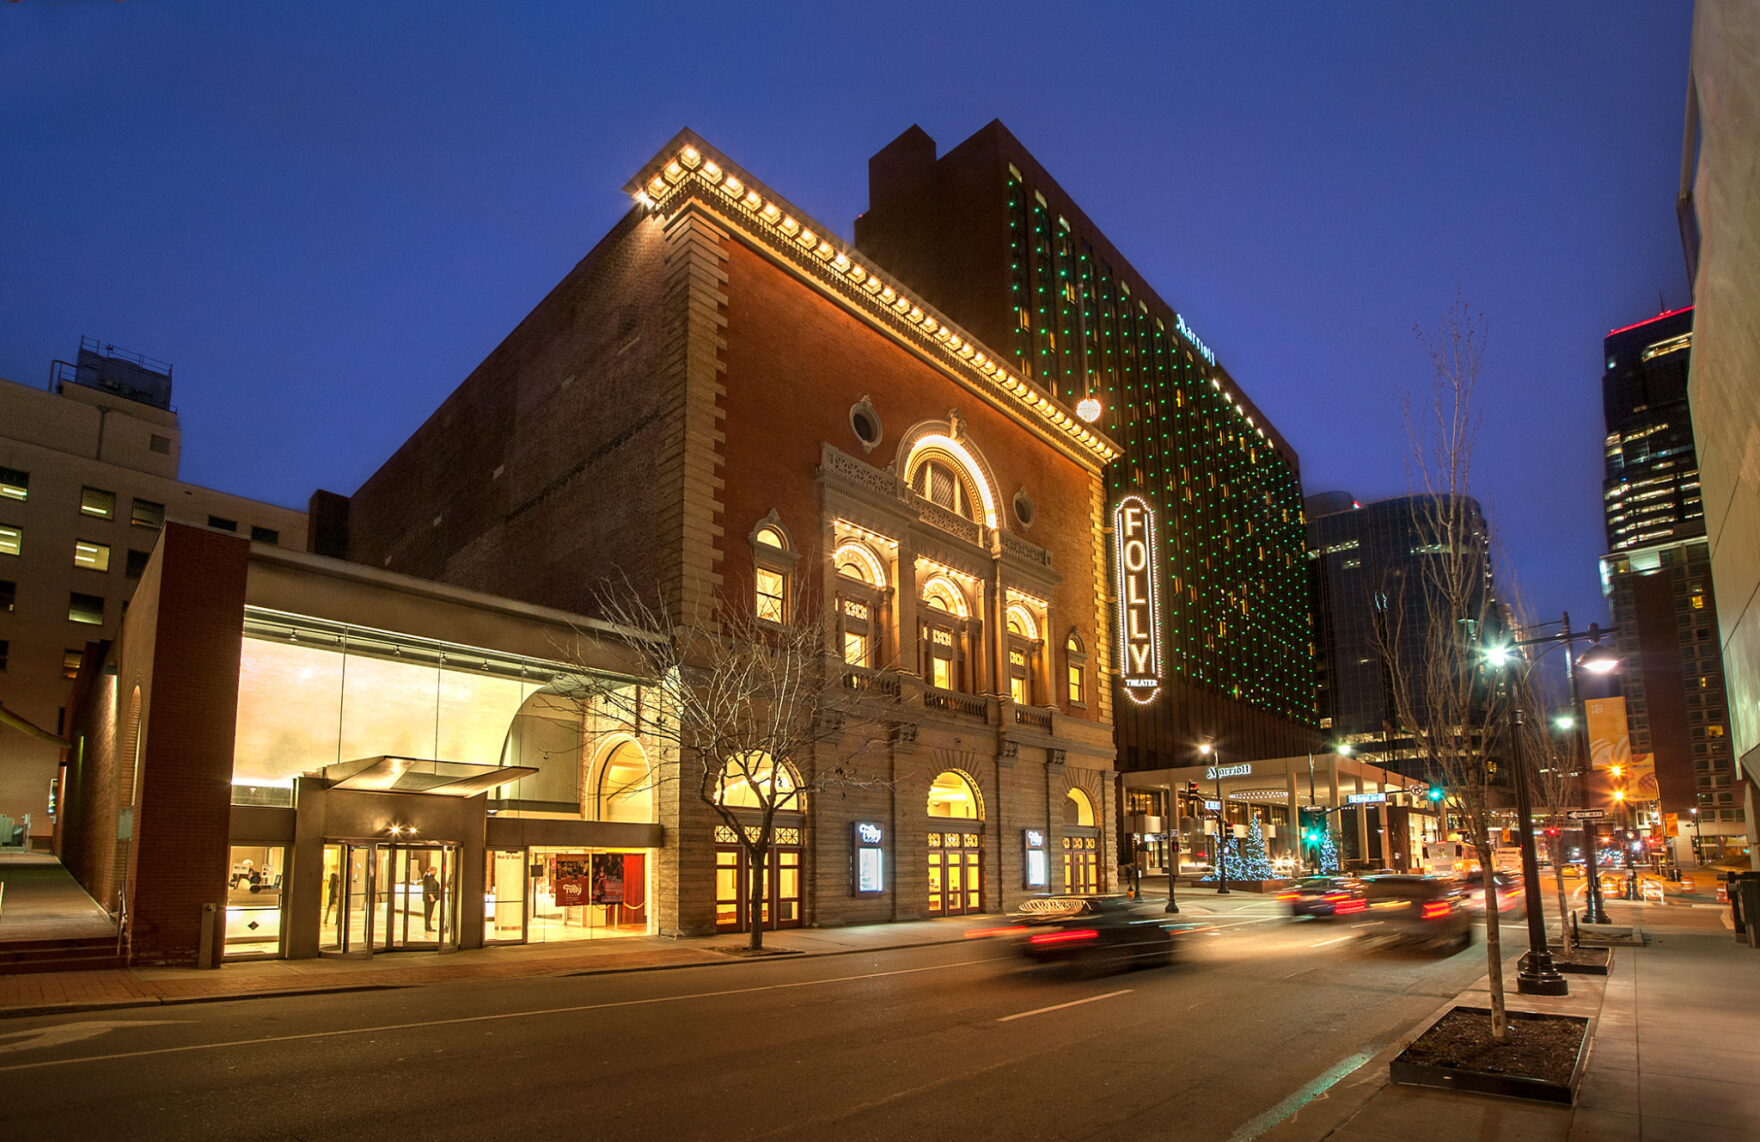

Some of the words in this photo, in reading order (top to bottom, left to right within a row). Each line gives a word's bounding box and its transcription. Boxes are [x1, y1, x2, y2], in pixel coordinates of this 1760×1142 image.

[1176, 313, 1215, 367] Marriott
[1124, 507, 1150, 674] FOLLY
[1125, 679, 1158, 688] THEATER
